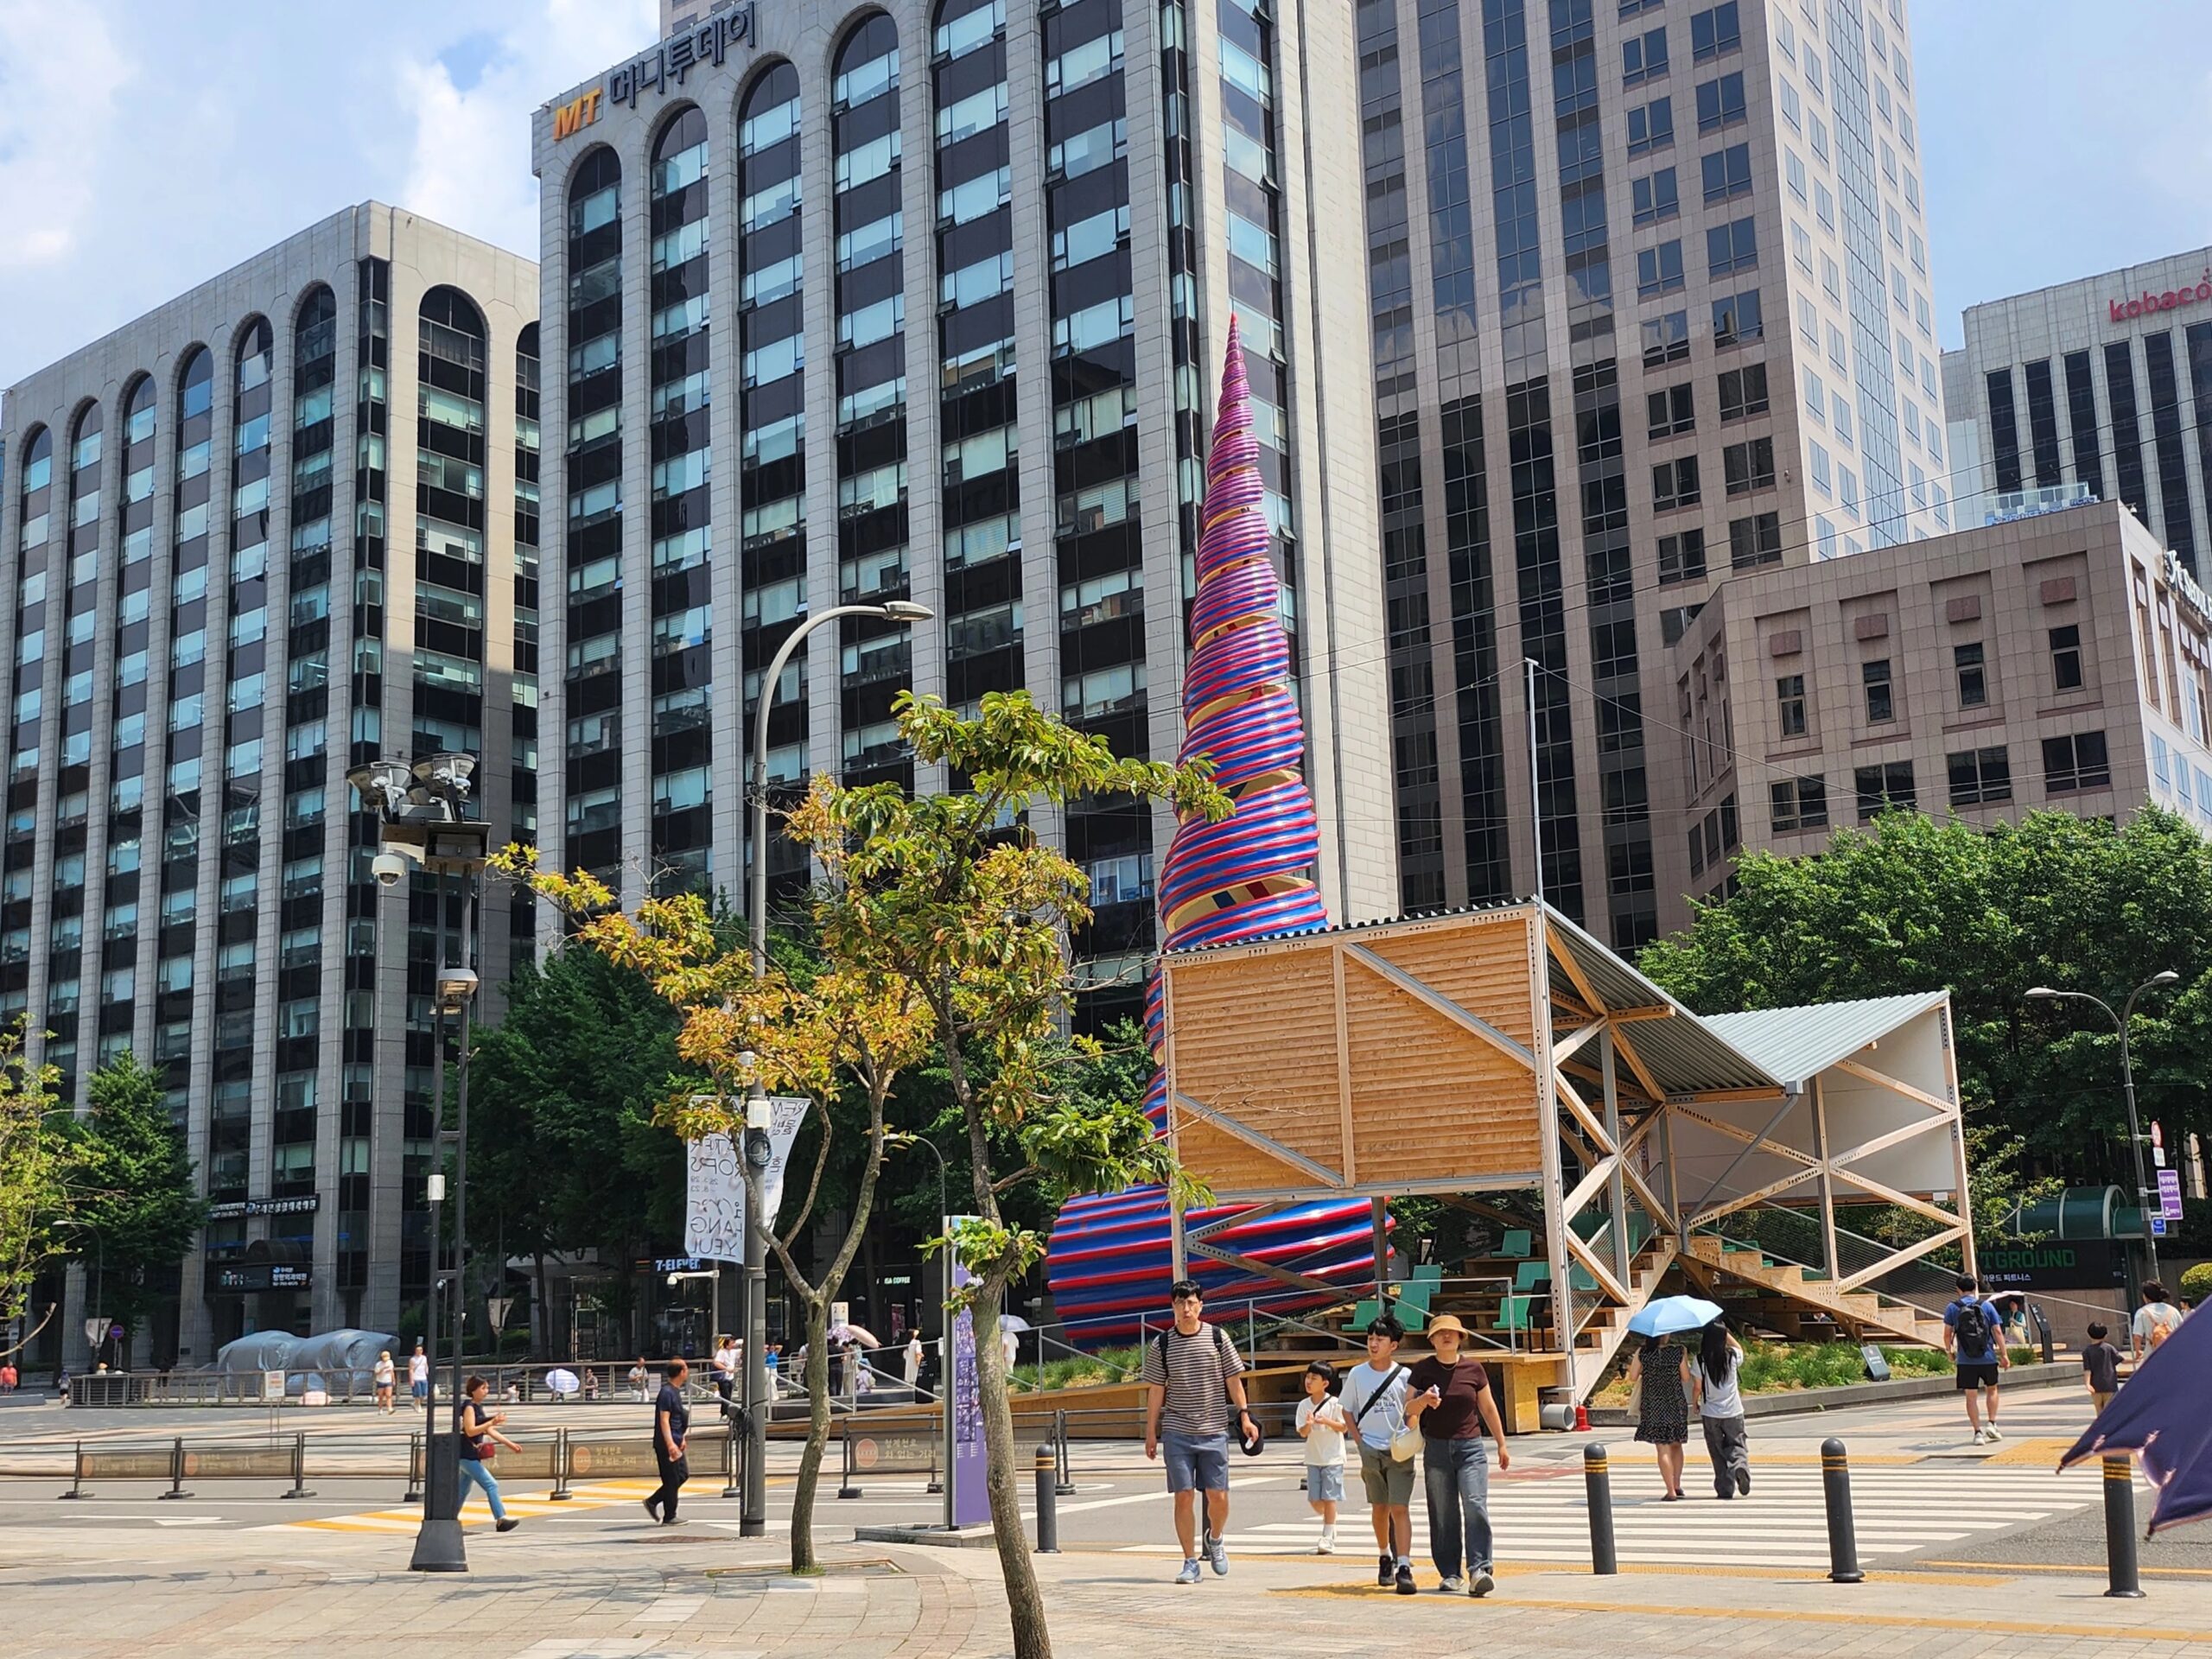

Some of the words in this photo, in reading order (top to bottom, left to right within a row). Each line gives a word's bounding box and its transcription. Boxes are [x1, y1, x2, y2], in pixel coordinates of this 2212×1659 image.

[553, 86, 603, 142] MT
[609, 1, 756, 110] 머니투데이
[2109, 282, 2212, 323] kobaco
[623, 1457, 637, 1465] 거리
[897, 1450, 914, 1459] 없는
[918, 1449, 937, 1459] 거리
